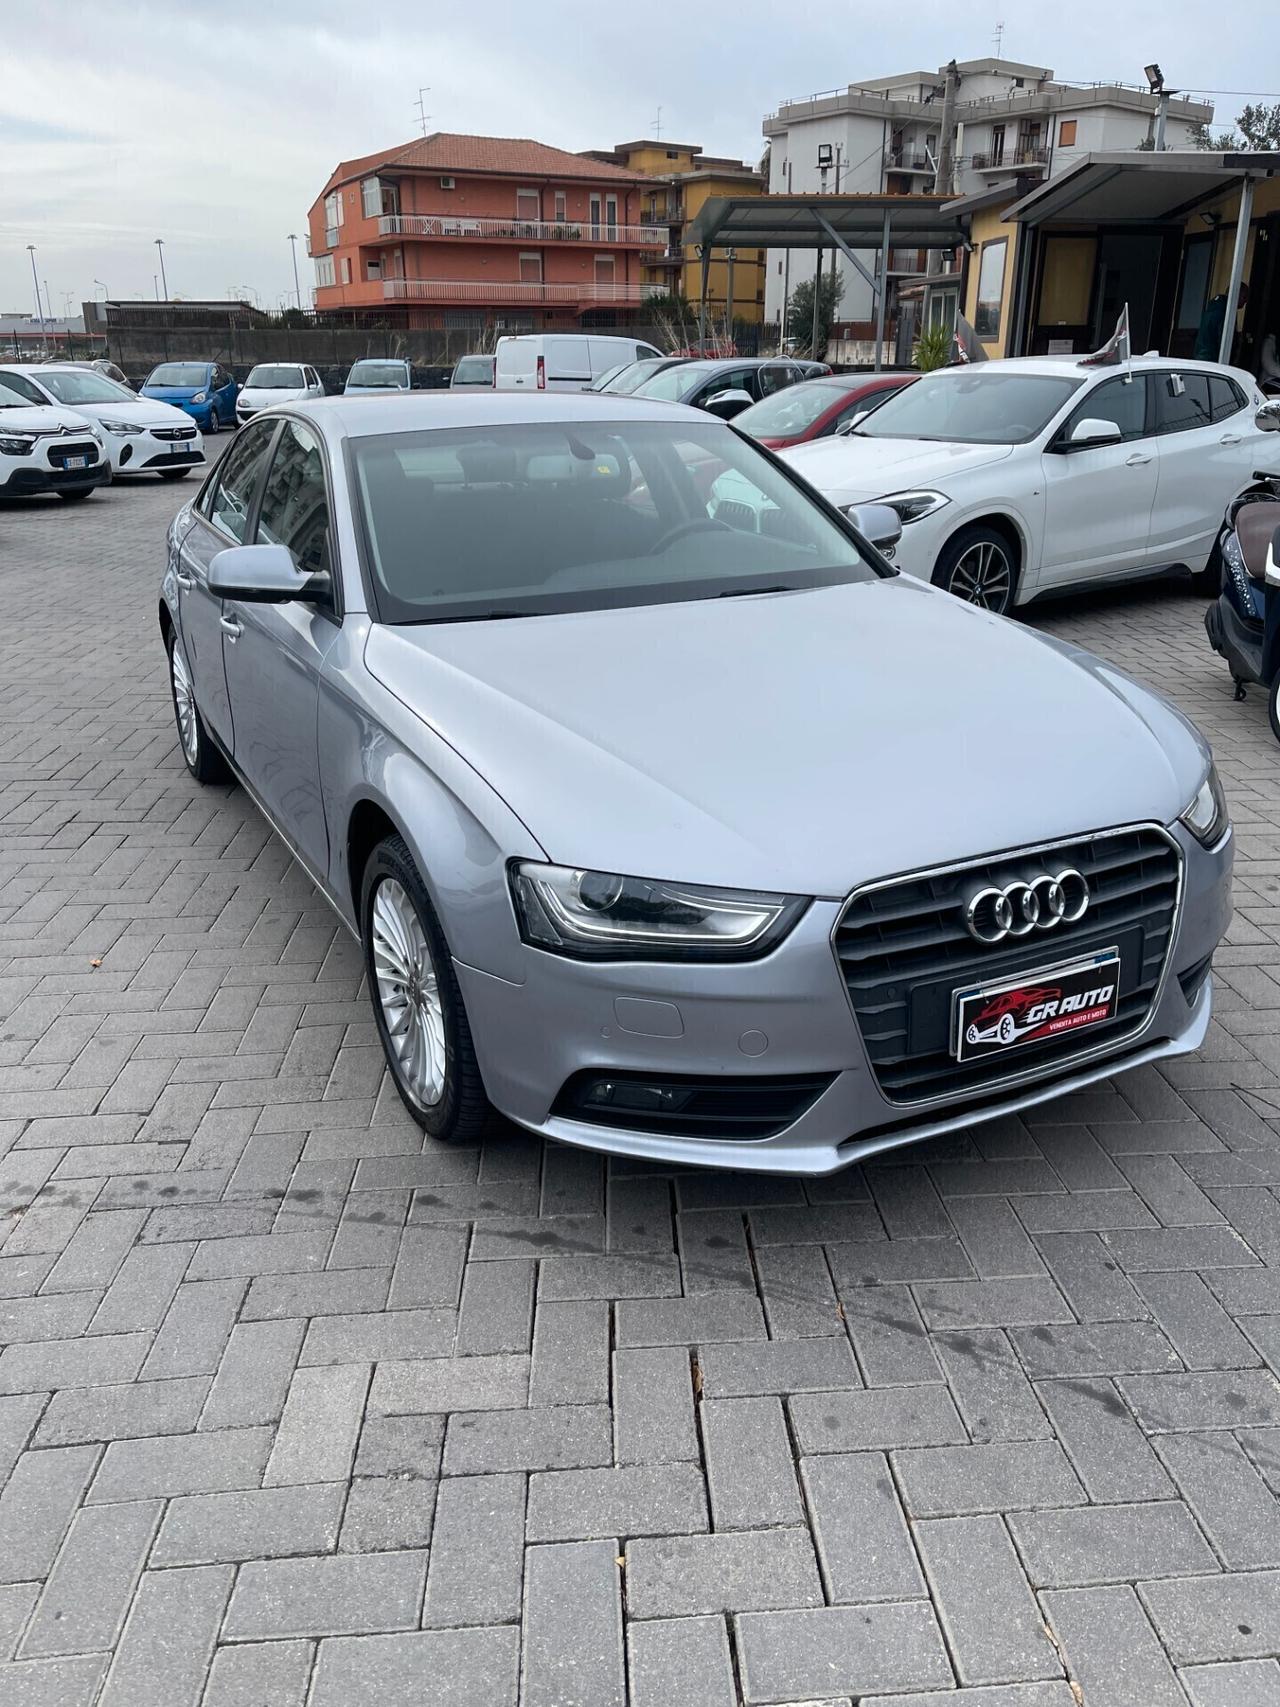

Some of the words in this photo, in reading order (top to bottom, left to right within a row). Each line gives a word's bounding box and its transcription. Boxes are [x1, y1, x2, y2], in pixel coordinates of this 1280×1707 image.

[1026, 1001, 1059, 1024] GR
[1059, 985, 1115, 1014] AUTO
[1049, 1019, 1072, 1031] VENDITA
[1073, 1014, 1087, 1024] AUTO
[1087, 1012, 1092, 1020] E
[1092, 1008, 1107, 1019] MOTO
